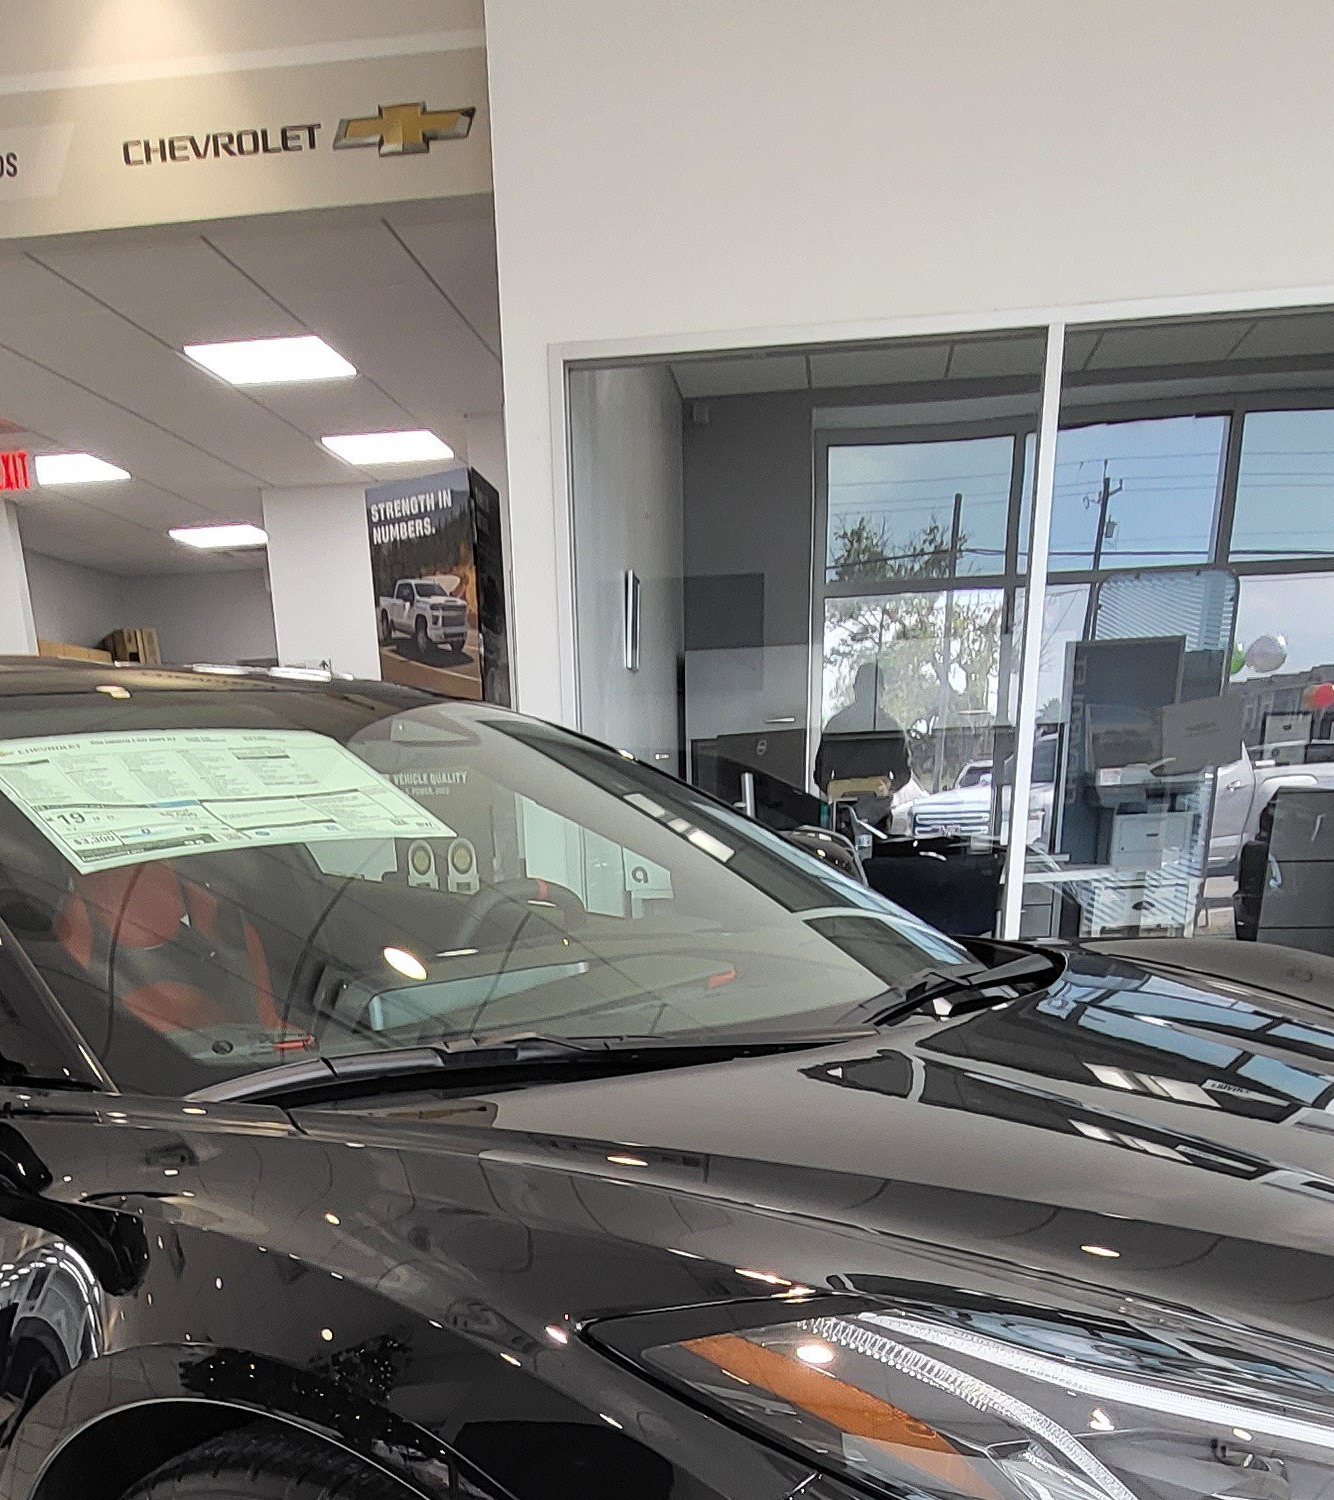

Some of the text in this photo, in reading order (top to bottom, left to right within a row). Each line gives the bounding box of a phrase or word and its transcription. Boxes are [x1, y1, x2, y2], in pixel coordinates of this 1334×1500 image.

[122, 123, 321, 167] CHEVROLET
[371, 488, 452, 523] STRENGTH IN
[373, 517, 436, 545] NUMBERS.
[430, 771, 467, 785] QUALITY
[57, 812, 86, 825] 19
